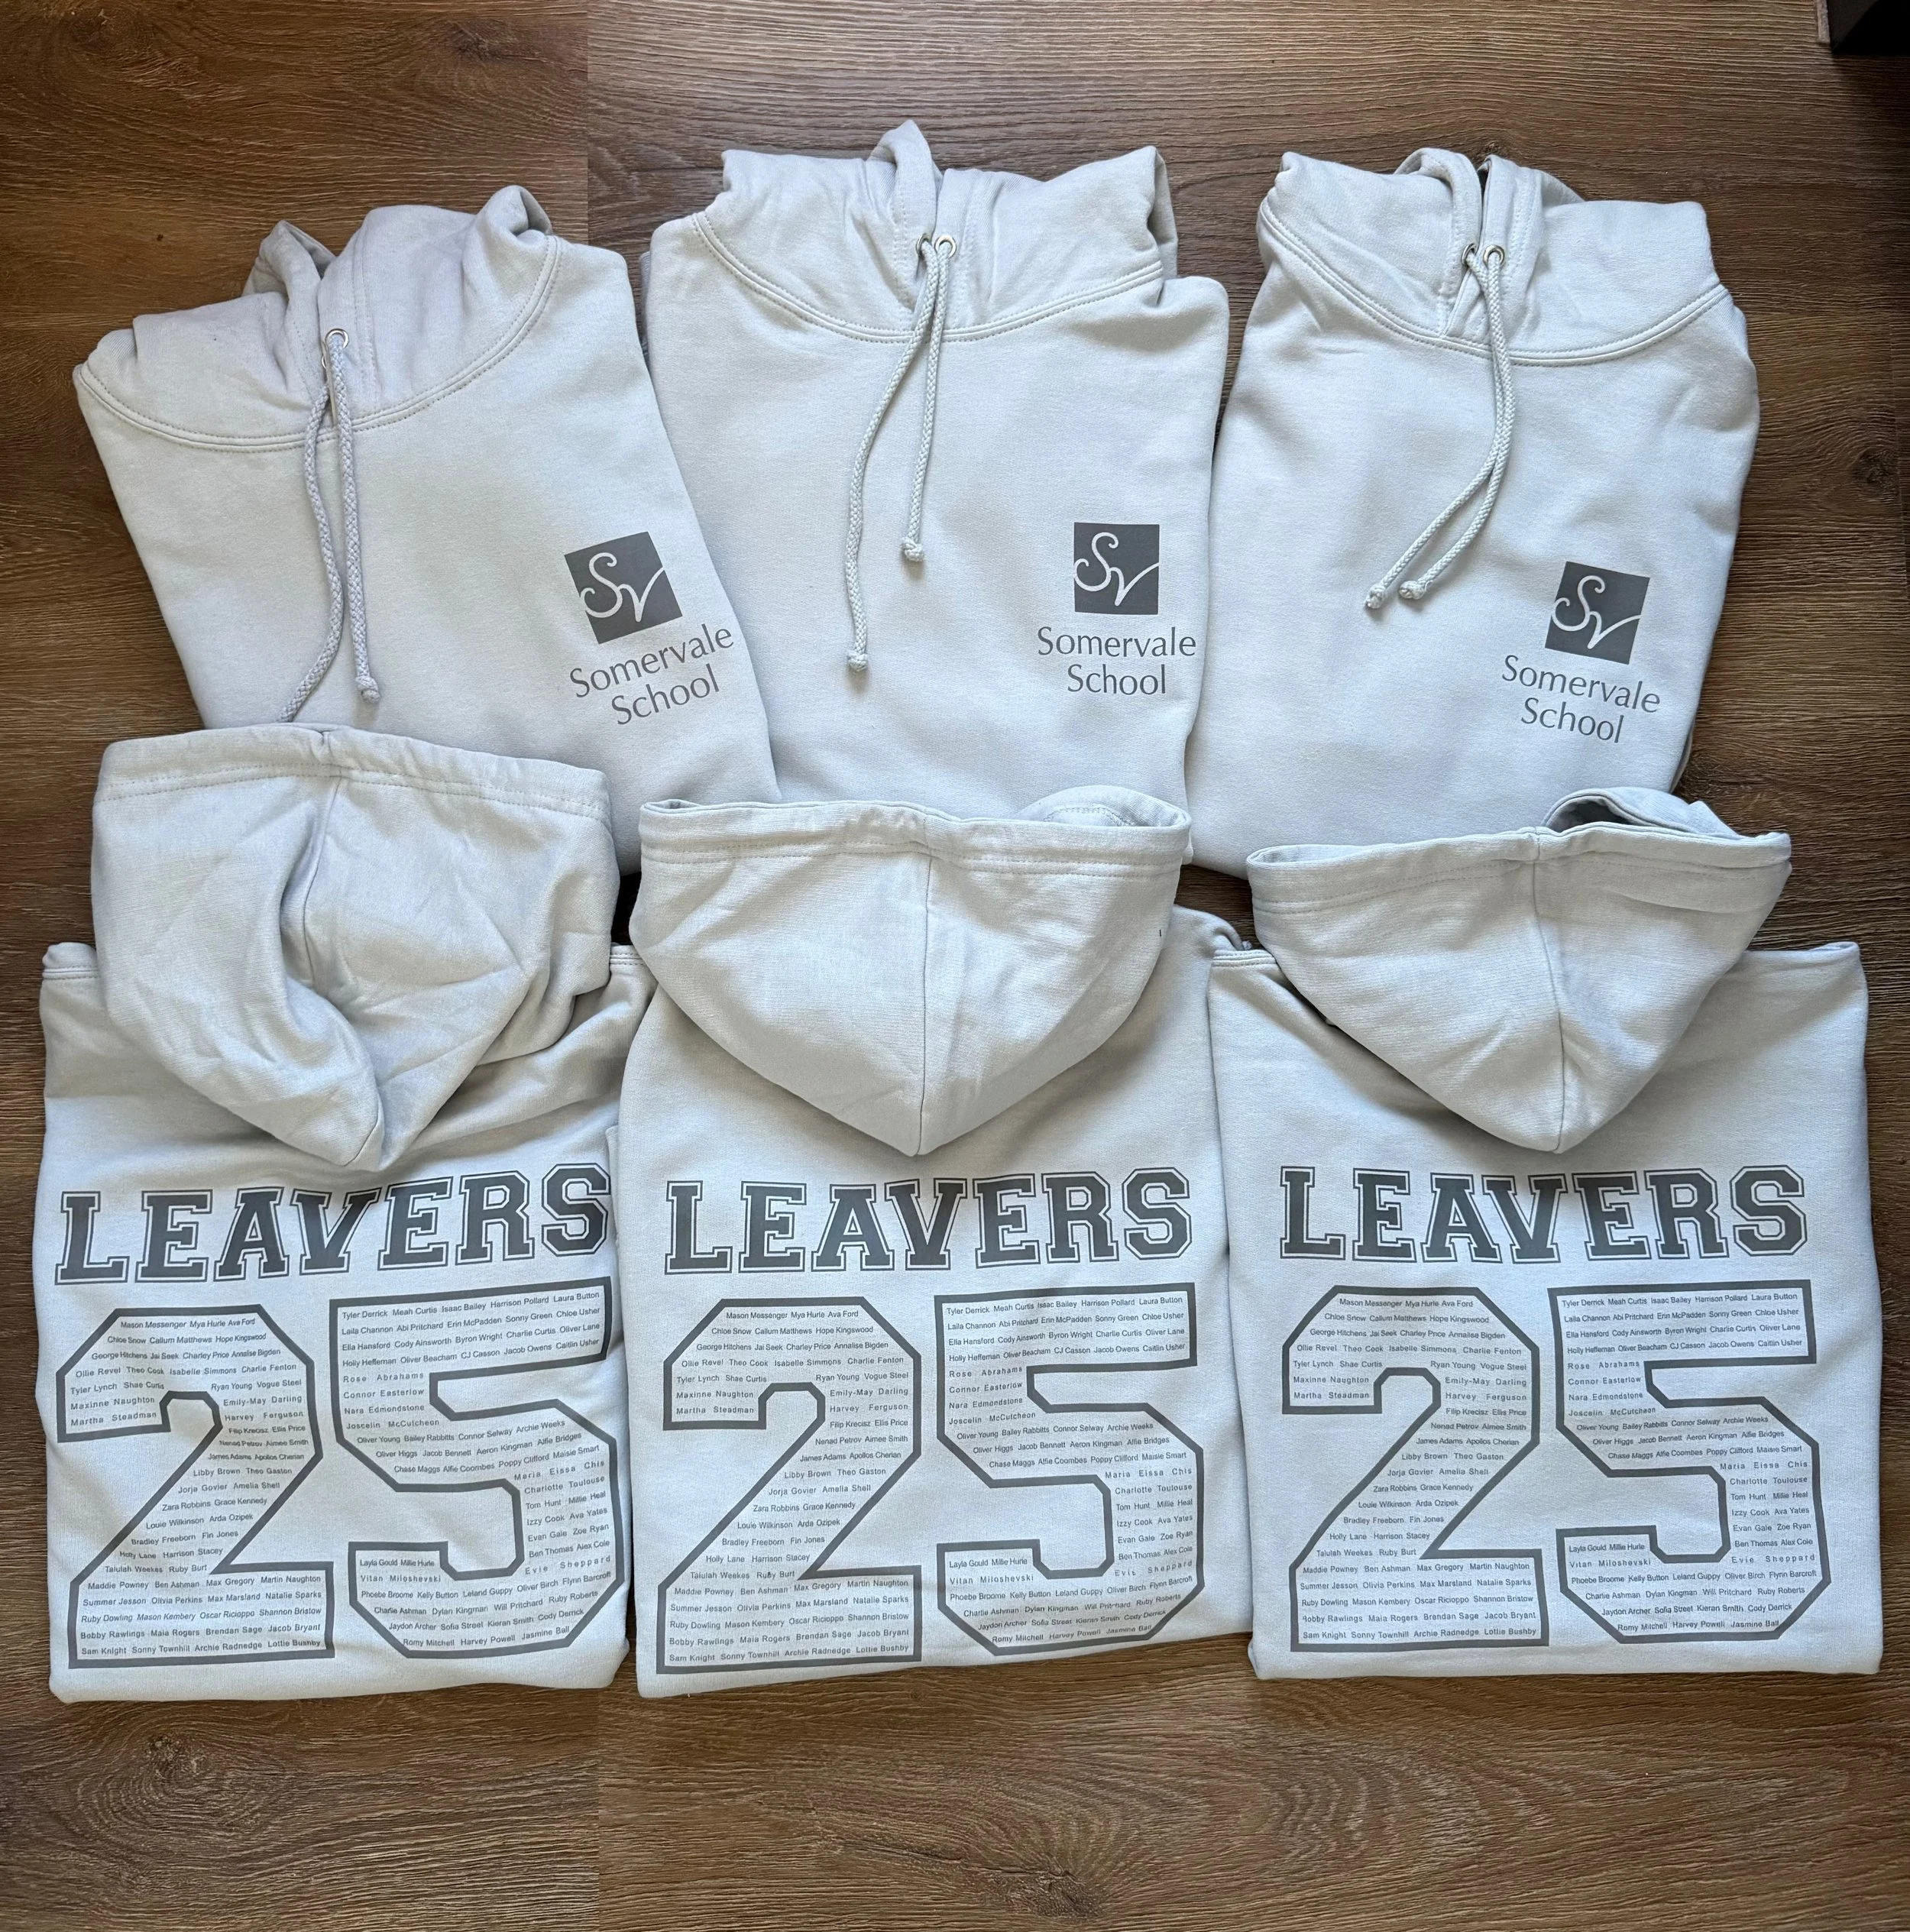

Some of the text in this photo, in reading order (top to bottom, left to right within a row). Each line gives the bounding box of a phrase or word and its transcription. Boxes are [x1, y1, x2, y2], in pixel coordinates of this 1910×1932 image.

[1038, 626, 1196, 657] Somervale
[570, 623, 734, 698] Somervale
[1067, 664, 1166, 695] School
[1502, 655, 1660, 713] Somervale
[612, 663, 719, 725] School
[1521, 697, 1624, 743] School
[664, 1167, 1193, 1275] LEAVERS
[1280, 1165, 1808, 1263] LEAVERS
[55, 1163, 610, 1285] LEAVERS
[342, 1312, 361, 1321] Tyler
[361, 1309, 388, 1318] Derrick
[415, 1306, 437, 1315] Curtis
[463, 1303, 487, 1311] Bailey
[490, 1299, 522, 1308] Harrison
[523, 1296, 549, 1305] Pollard
[576, 1292, 600, 1300] Button
[1708, 1310, 1730, 1319] Sonny
[144, 1321, 187, 1329] Messenger
[189, 1320, 206, 1329] Mya
[835, 1326, 873, 1335] Kingswood
[75, 1370, 95, 1378] Ollie
[97, 1367, 121, 1375] Revel
[241, 1364, 267, 1373] Charlie
[815, 1374, 835, 1383] Ryan
[837, 1374, 860, 1382] Young
[863, 1373, 888, 1381] Vogue
[981, 1367, 1022, 1376] Abrahams
[1330, 1376, 1369, 1385] Naughton
[830, 1387, 908, 1397] Emily-May Darling
[1445, 1392, 1526, 1402] Harvey Ferguson
[1592, 1392, 1643, 1400] Edmondstone
[70, 1396, 155, 1409] Maxinne Naughton
[869, 1403, 908, 1412] Ferguson
[972, 1398, 1022, 1408] Edmondstone
[70, 1412, 157, 1426] Martha Steadman
[948, 1416, 982, 1425] Joscelin
[1330, 1565, 1358, 1574] Powney
[1364, 1565, 1379, 1573] Ben
[1434, 1563, 1464, 1572] Gregory
[1494, 1562, 1530, 1571] Naughton
[119, 1581, 149, 1590] Powney
[225, 1578, 255, 1586] Gregory
[285, 1575, 321, 1584] Naughton
[1627, 1574, 1646, 1584] Kelly
[1697, 1572, 1721, 1581] Guppy
[1769, 1571, 1788, 1580] Flynn
[1789, 1569, 1817, 1578] Barcroft
[670, 1604, 702, 1612] Summer
[813, 1597, 848, 1607] Marsland
[853, 1596, 880, 1604] Natalie
[882, 1595, 908, 1604] Sparks
[689, 1654, 715, 1662] Knight
[747, 1650, 779, 1659] Townhill
[811, 1647, 851, 1655] Radnedge
[880, 1644, 908, 1652] Bushby
